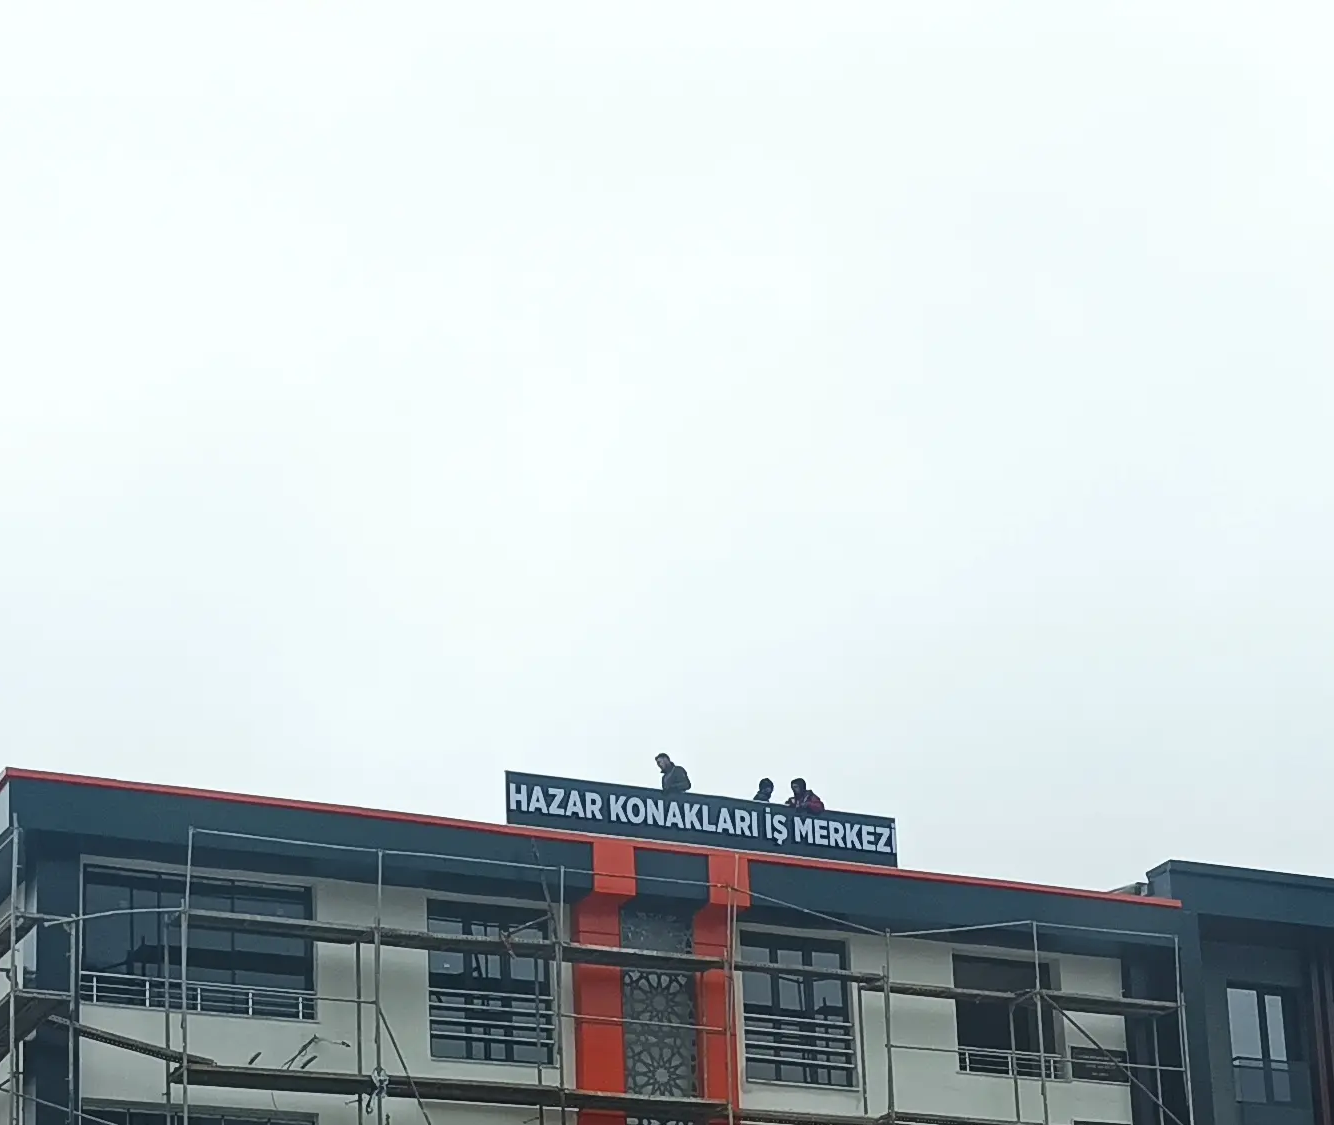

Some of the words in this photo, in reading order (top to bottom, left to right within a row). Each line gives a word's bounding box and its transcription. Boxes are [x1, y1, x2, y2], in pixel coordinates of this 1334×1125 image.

[509, 782, 603, 820] HAZAR
[610, 794, 758, 838] KONAKLARI
[765, 807, 787, 846] İŞ
[794, 816, 896, 854] MERKEZİ
